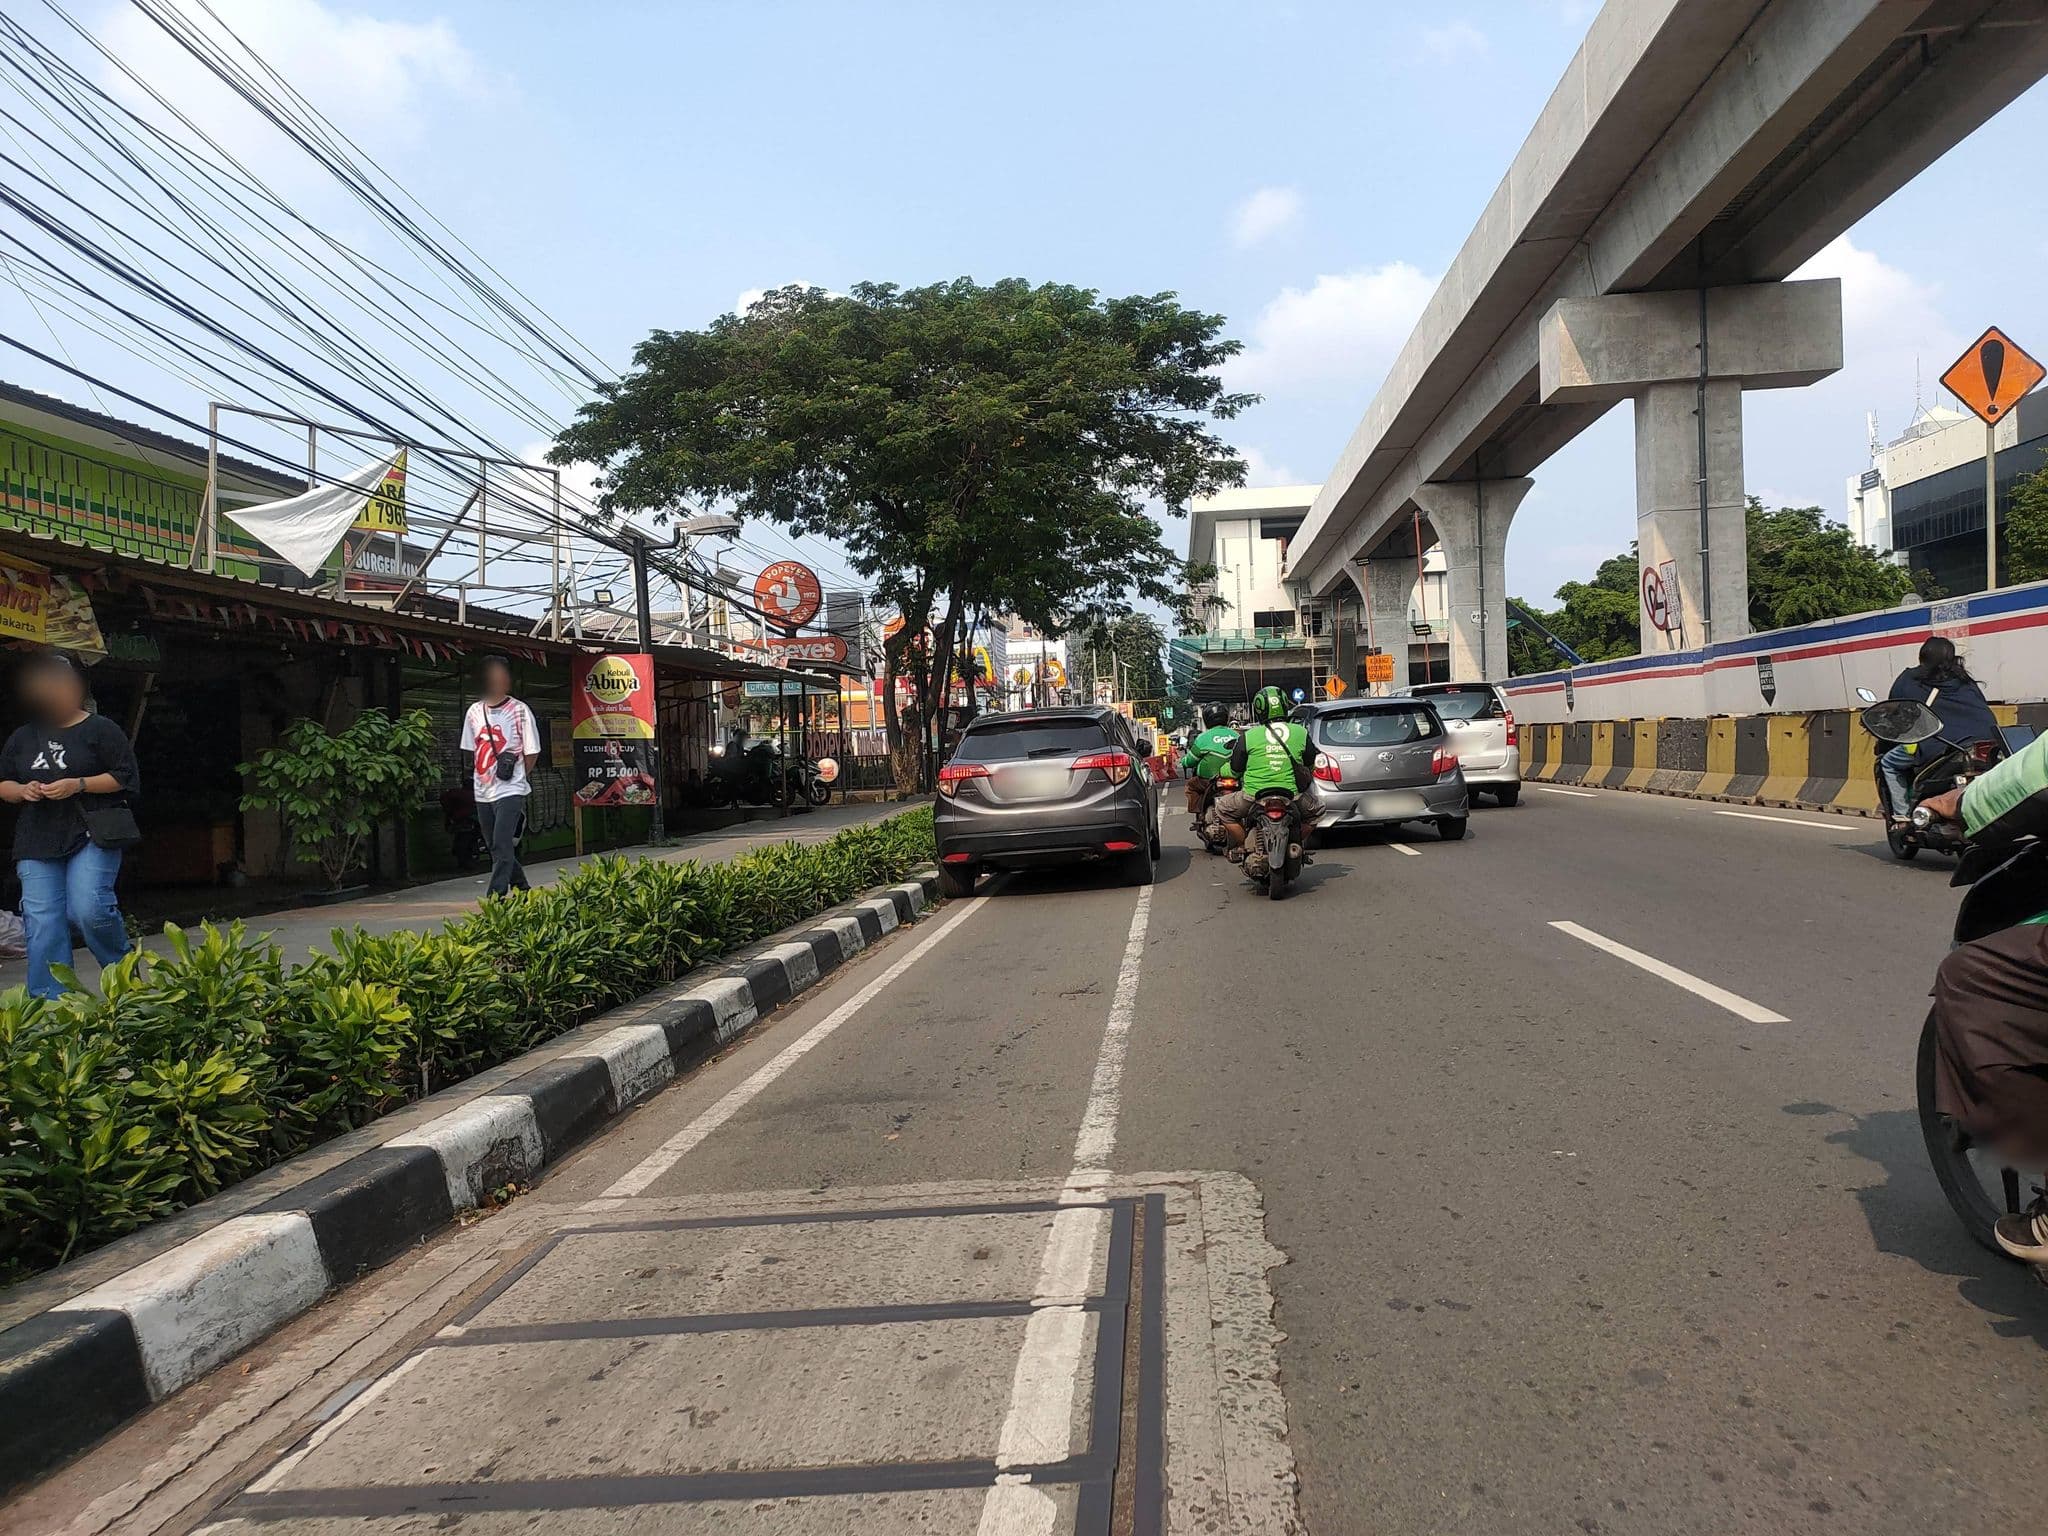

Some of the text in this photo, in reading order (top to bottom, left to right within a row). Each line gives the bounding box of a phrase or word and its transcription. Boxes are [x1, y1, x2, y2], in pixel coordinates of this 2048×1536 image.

[356, 551, 396, 575] BURGER
[607, 669, 631, 677] Kebuli
[586, 674, 638, 695] Abuya
[588, 767, 639, 777] RP 15.000
